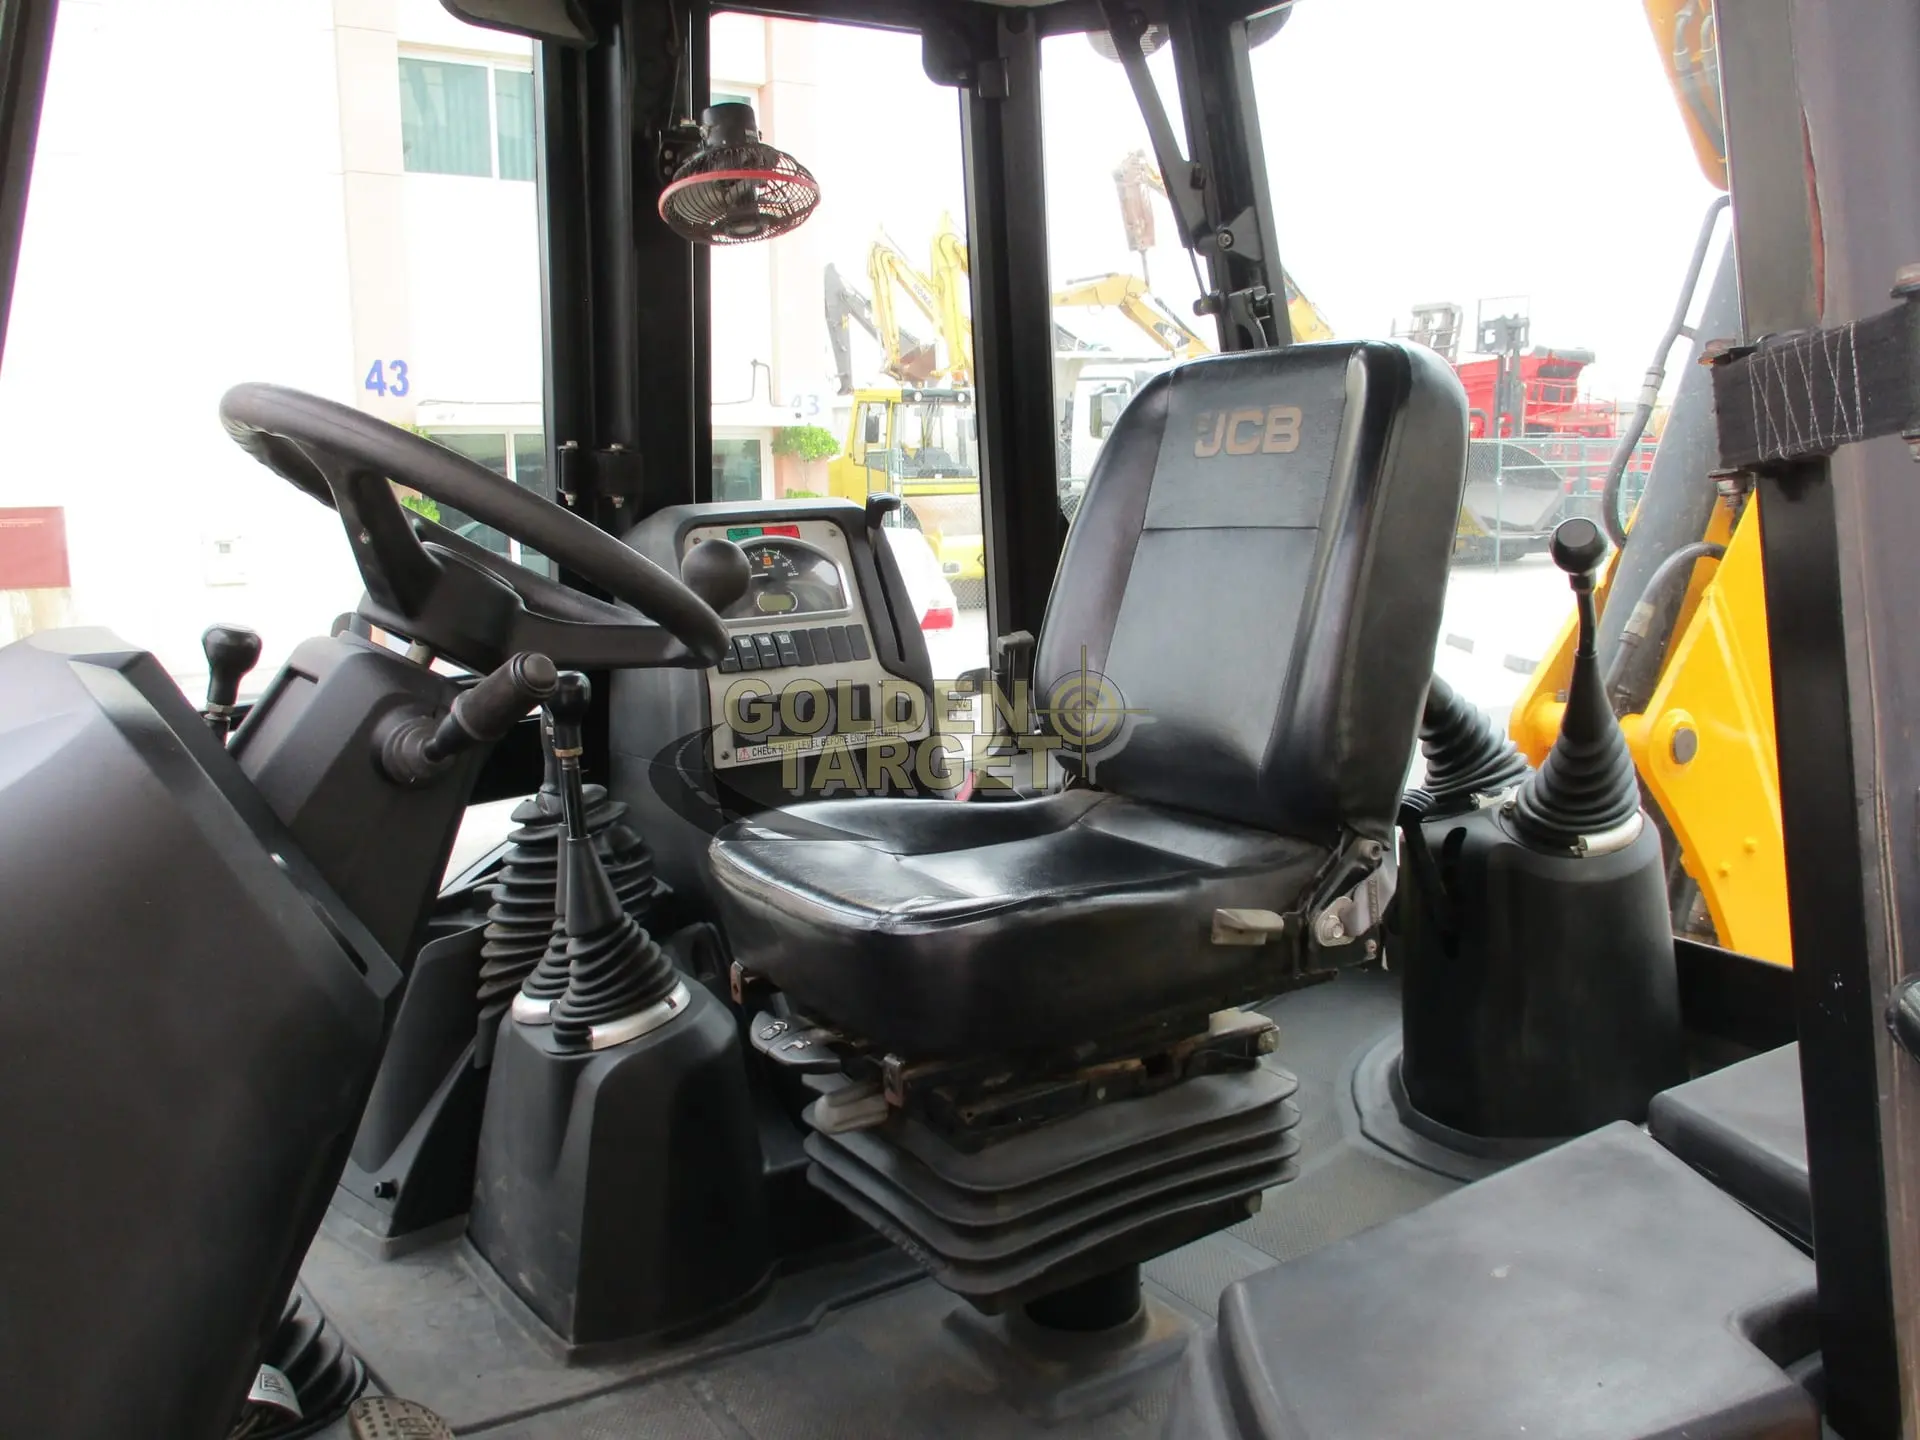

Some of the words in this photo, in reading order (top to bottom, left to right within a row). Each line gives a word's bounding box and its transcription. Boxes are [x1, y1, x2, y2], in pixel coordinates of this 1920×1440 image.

[365, 359, 409, 397] 43
[1194, 404, 1302, 458] JCB
[752, 743, 777, 757] CHECK
[797, 736, 821, 750] LEVEL
